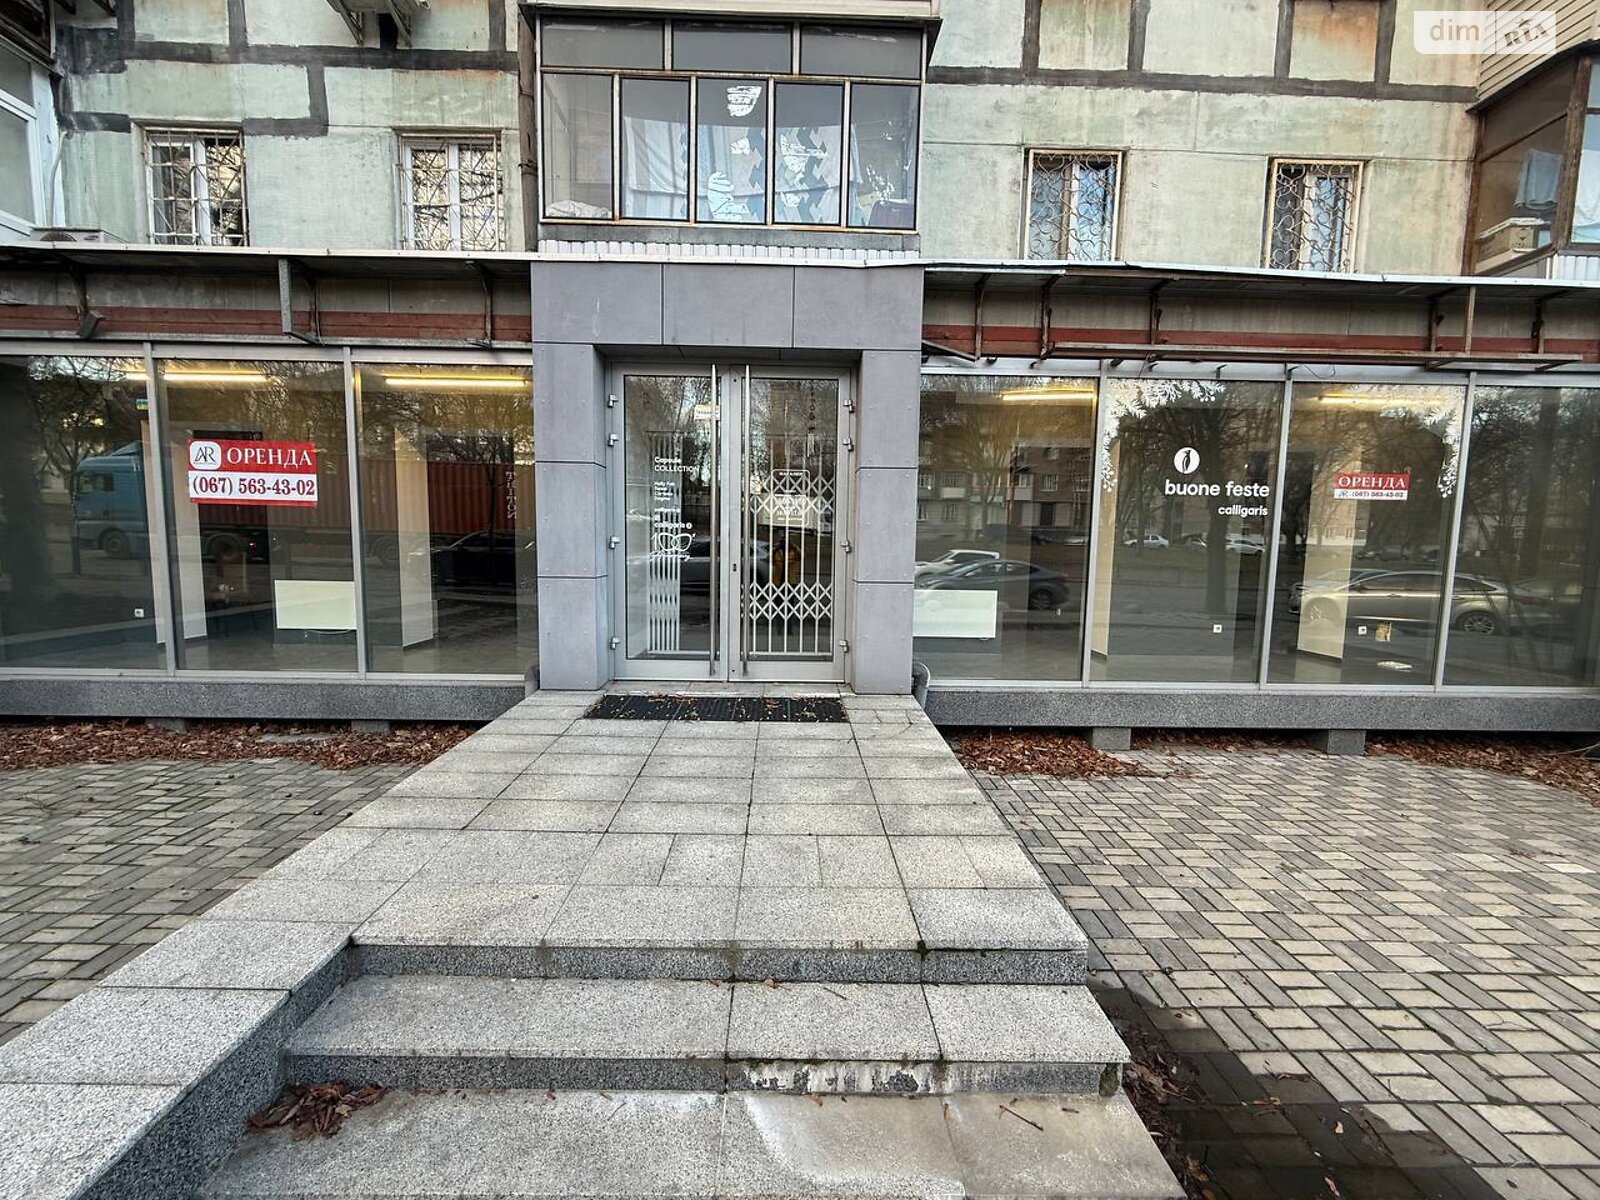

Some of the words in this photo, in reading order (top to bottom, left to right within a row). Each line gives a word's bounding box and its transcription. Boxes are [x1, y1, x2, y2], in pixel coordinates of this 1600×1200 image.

[227, 447, 312, 469] ОРЕНДА
[193, 476, 233, 495] (067)
[238, 478, 315, 496] 563-43-02
[1164, 479, 1220, 496] buone
[1225, 481, 1270, 497] feste
[1338, 476, 1405, 489] ОРЕНДА
[1218, 504, 1268, 518] calligaris
